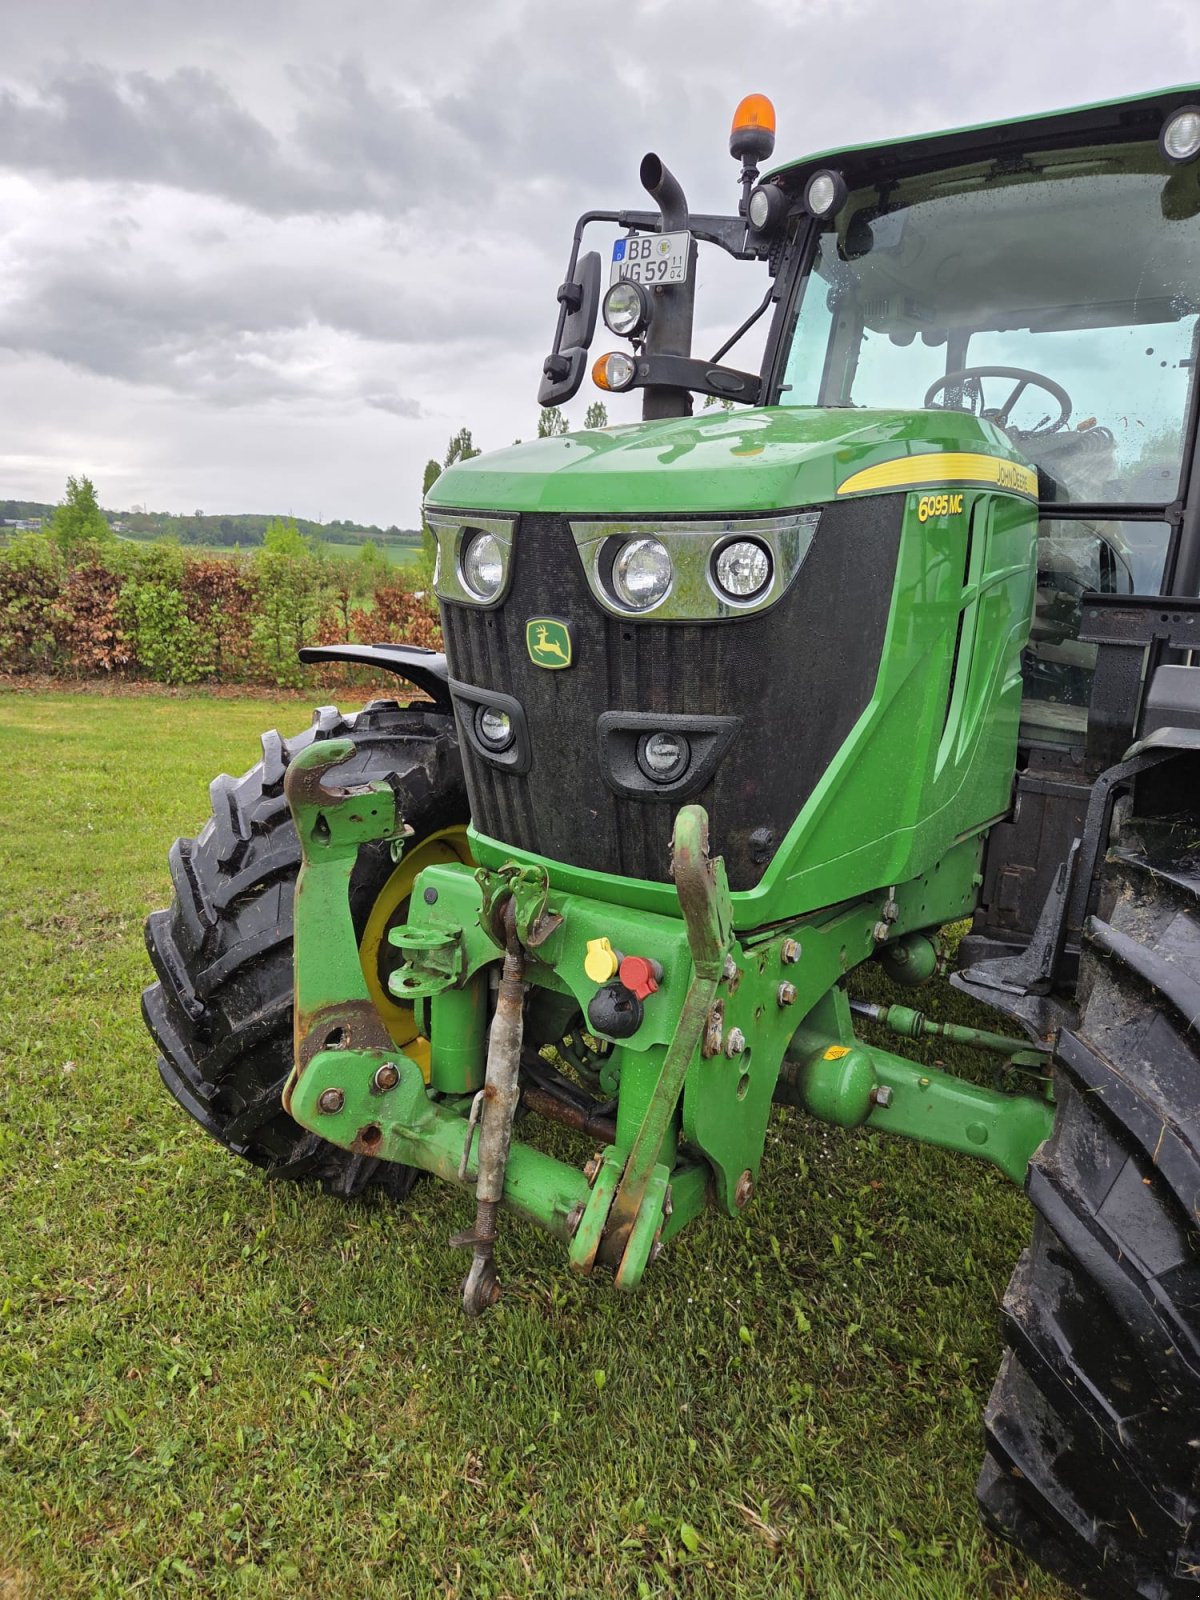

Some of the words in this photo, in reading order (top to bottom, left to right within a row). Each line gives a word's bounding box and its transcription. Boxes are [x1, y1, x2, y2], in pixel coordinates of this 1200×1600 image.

[628, 240, 652, 260] BB
[645, 260, 668, 281] 59
[670, 270, 681, 279] 04
[918, 495, 949, 522] 6095
[949, 494, 963, 514] MC
